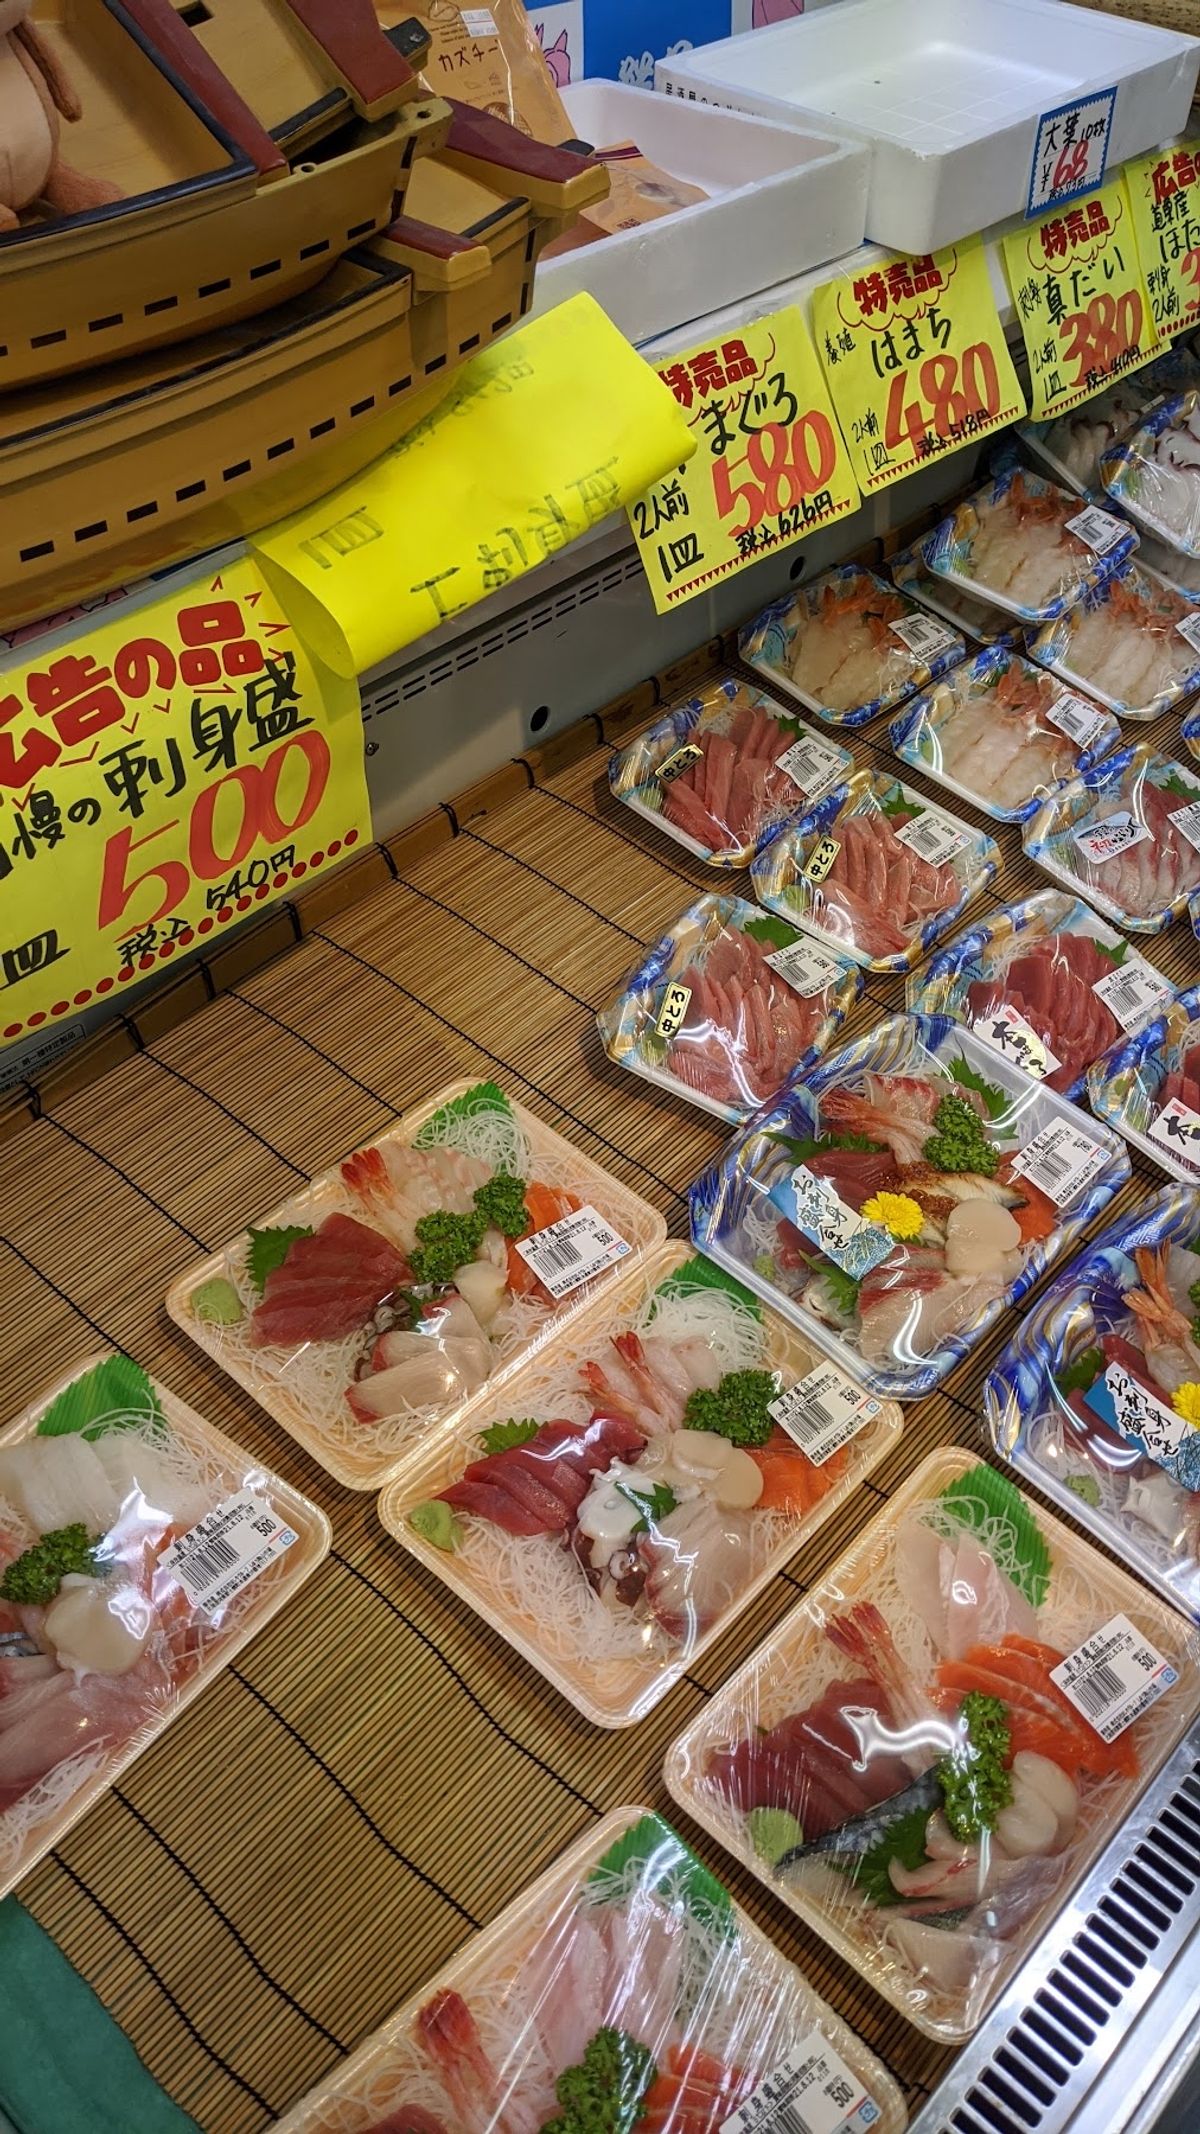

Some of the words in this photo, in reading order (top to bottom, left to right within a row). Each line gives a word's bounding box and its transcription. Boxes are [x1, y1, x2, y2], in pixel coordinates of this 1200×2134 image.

[1040, 200, 1110, 258] 特売品
[853, 254, 943, 316] 特売品
[1043, 246, 1126, 326] 真だい
[1152, 287, 1180, 322] 2人前
[872, 307, 951, 378] はまち
[1059, 289, 1143, 387] 380
[701, 373, 798, 455] まぐろ
[885, 342, 1000, 456] 480
[711, 410, 836, 537] 580
[863, 442, 896, 476] 1皿
[634, 483, 689, 540] 2人前
[658, 533, 704, 583] 1皿
[0, 652, 315, 879] 慢の刺身盛
[663, 748, 698, 781] 中とろ
[99, 729, 331, 942] 500
[811, 841, 835, 876] 中とろ
[661, 991, 686, 1032] 中とろ
[596, 1231, 614, 1246] 500
[843, 1389, 861, 1405] 500
[1107, 1373, 1171, 1432] お刺身
[256, 1518, 277, 1537] 500
[1138, 1652, 1158, 1672] 500
[738, 2062, 794, 2123] 刺身盛合せ
[830, 2082, 855, 2109] 500
